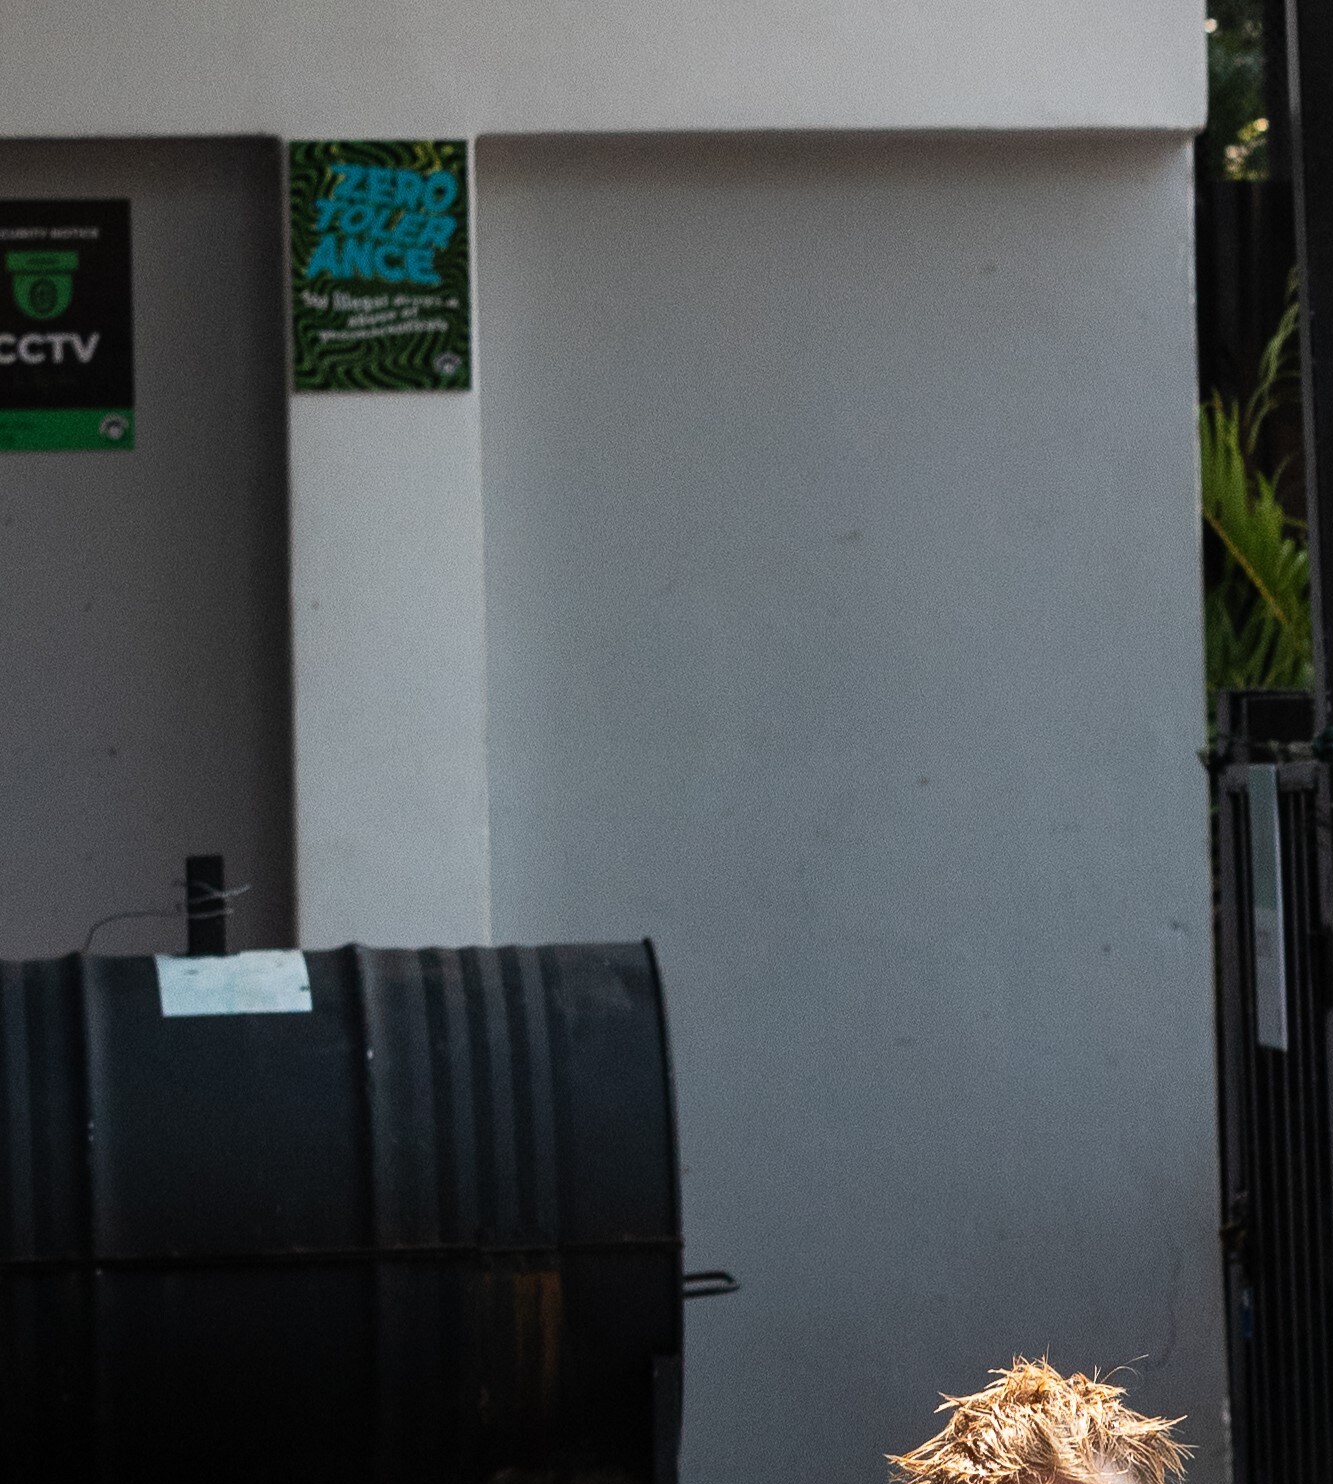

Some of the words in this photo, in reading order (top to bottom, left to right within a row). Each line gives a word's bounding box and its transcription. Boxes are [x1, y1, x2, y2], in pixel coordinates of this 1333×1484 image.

[330, 163, 459, 212] ZERO
[0, 227, 48, 239] CURITY
[315, 199, 457, 250] TOLER
[306, 233, 441, 286] ANCE
[0, 331, 99, 363] CCTV
